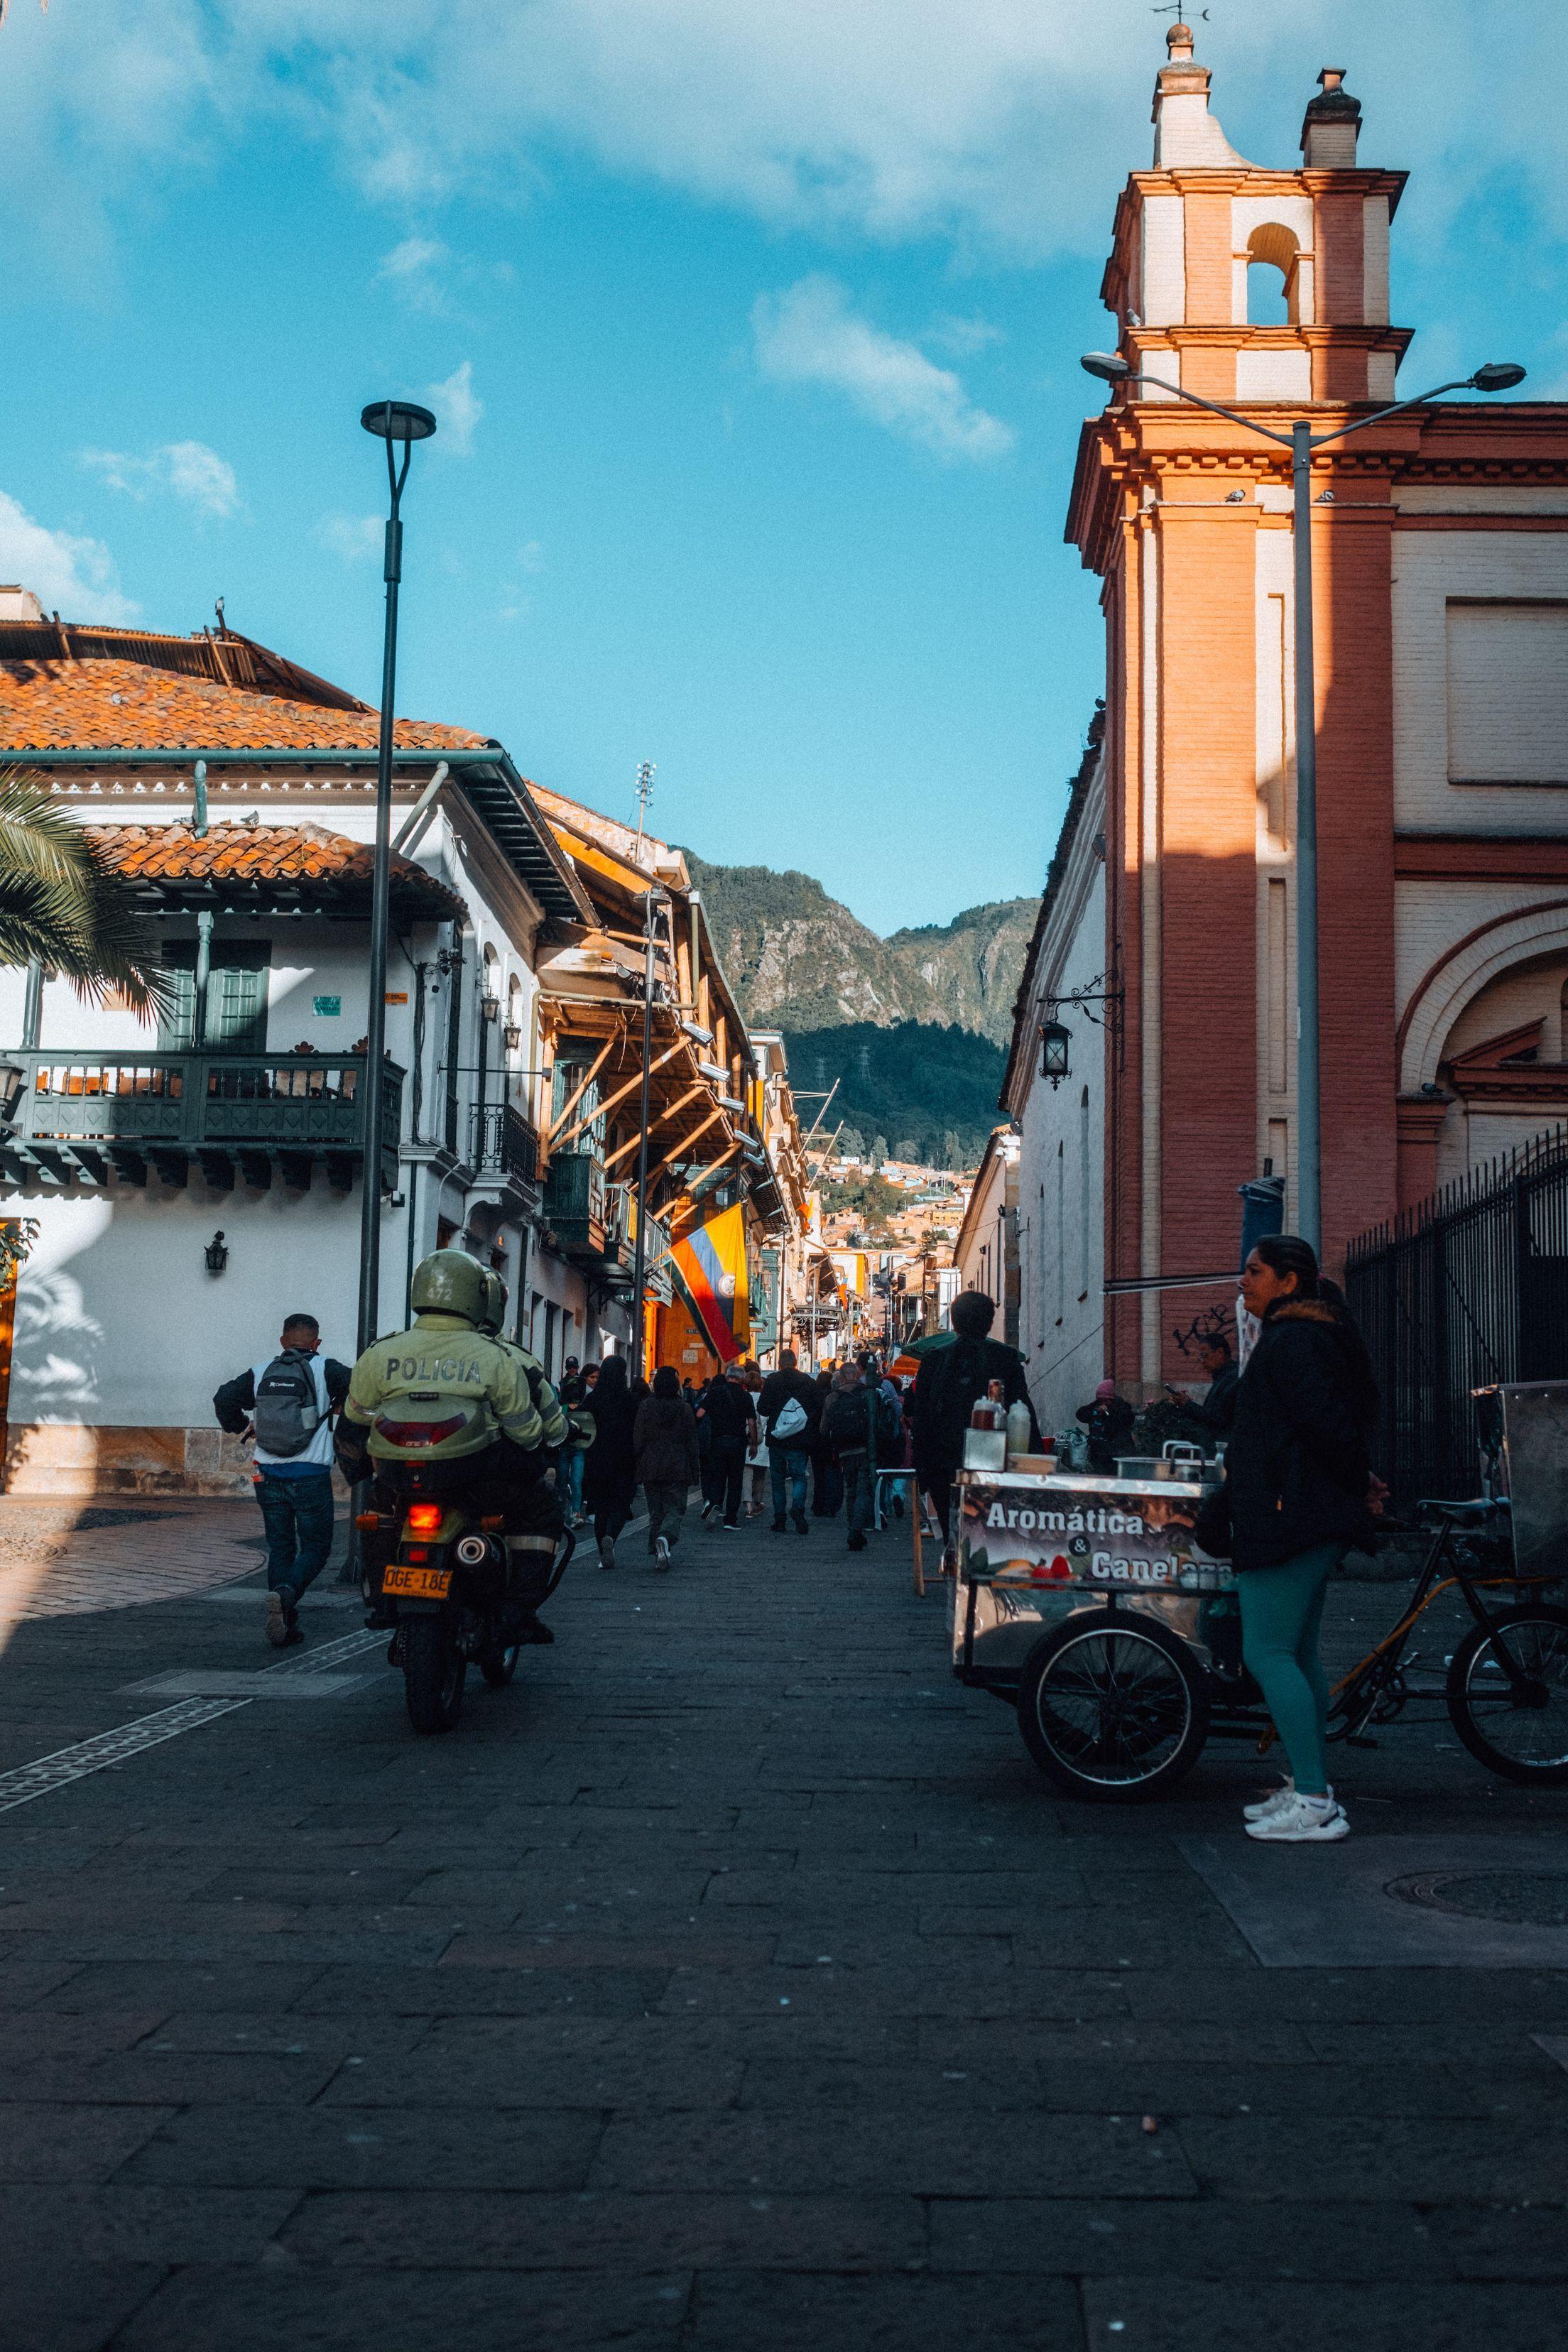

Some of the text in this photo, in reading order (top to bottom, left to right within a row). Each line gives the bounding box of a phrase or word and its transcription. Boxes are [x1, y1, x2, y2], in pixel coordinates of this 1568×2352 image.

[386, 1358, 481, 1383] POLICIA
[986, 1502, 1144, 1535] Aromática
[1074, 1538, 1087, 1553] &
